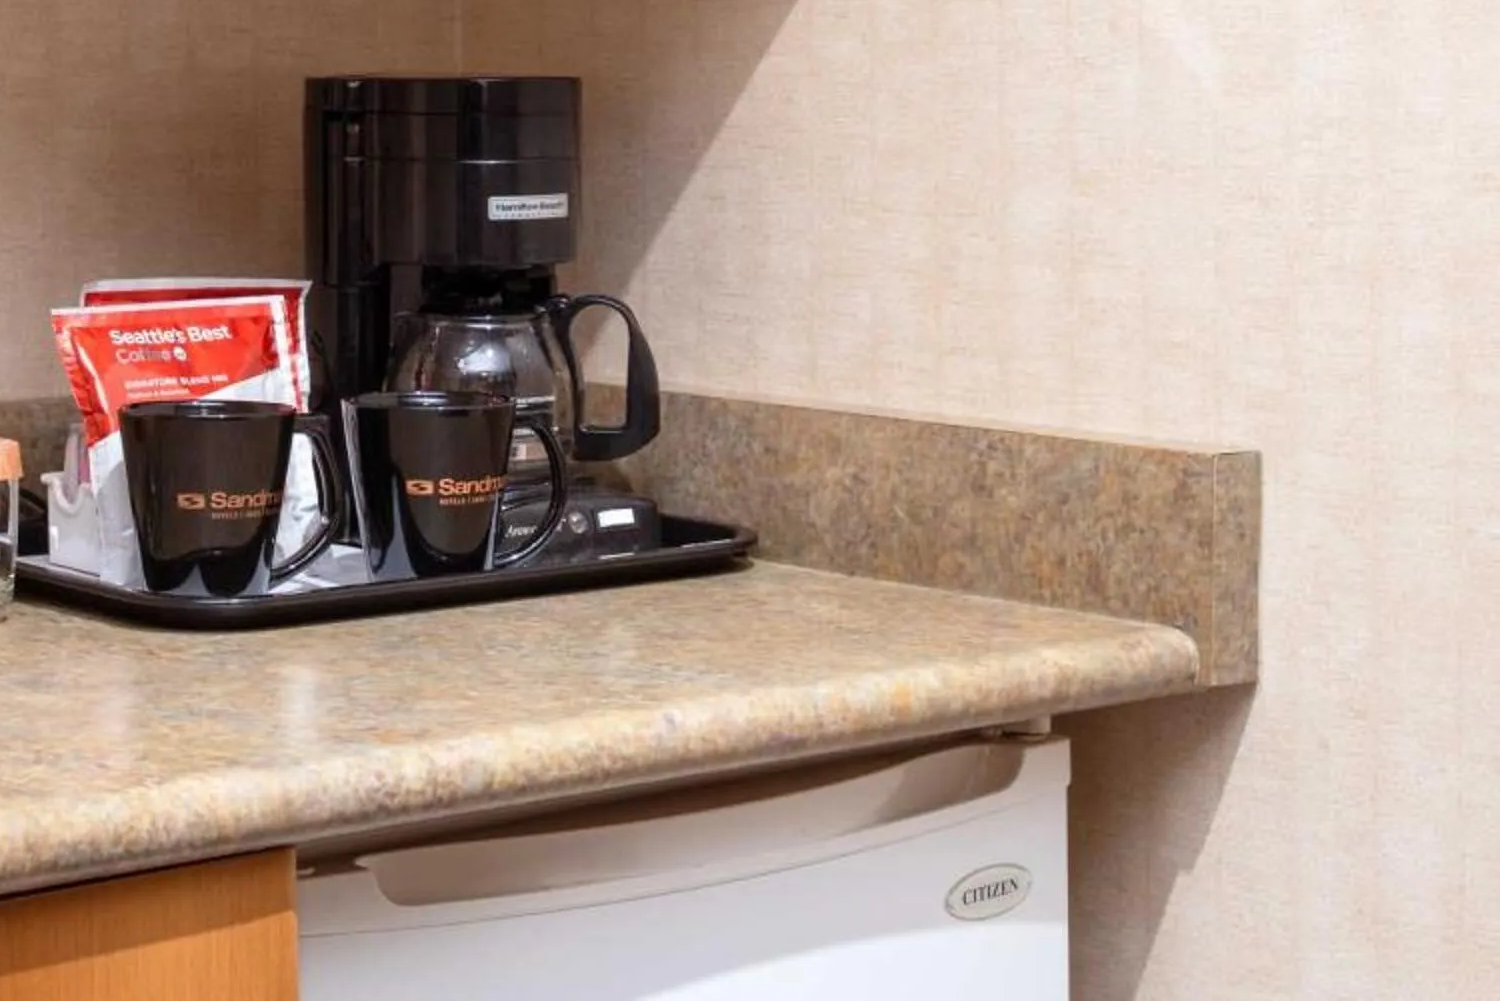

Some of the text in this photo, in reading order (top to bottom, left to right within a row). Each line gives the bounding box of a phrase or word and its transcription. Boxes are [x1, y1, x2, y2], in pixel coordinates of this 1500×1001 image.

[108, 324, 232, 345] Seattle's Best
[962, 877, 1018, 906] CITIZEN
